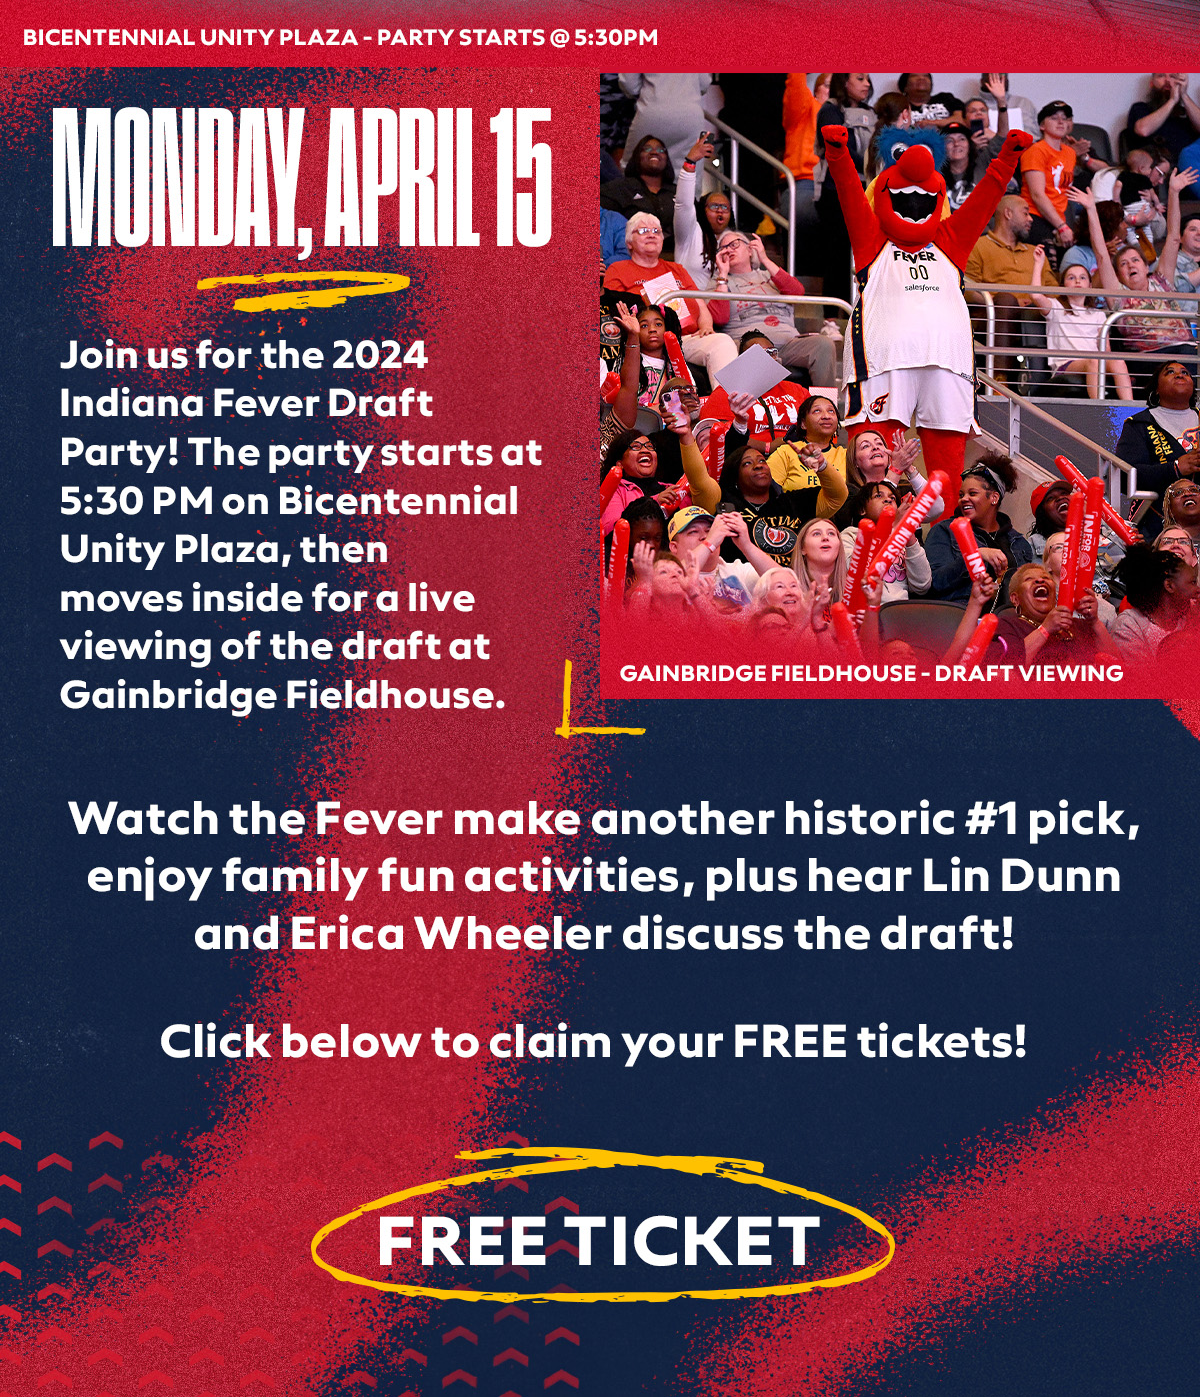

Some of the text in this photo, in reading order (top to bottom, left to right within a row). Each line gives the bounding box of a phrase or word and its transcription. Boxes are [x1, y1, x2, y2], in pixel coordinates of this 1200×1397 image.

[52, 106, 552, 261] MONDAY, APRIL 15
[893, 250, 937, 264] FEVER
[909, 265, 929, 280] 00
[904, 284, 940, 292] salesforce
[60, 338, 429, 369] Join us for the 2024
[61, 386, 433, 417] Indiana Fever Draft
[61, 436, 542, 474] Party! The party starts at
[1146, 424, 1168, 465] INDIANA
[60, 484, 518, 515] 5:30 PM on Bicentennial
[883, 493, 935, 563] MAKE NOISE
[1083, 514, 1095, 552] INFOR
[61, 532, 388, 571] Unity Plaza, then
[61, 581, 475, 612] moves inside for a live
[59, 629, 490, 668] viewing of the draft at
[60, 678, 505, 717] Gainbridge Fieldhouse.
[67, 799, 1139, 844] Watch the Fever make another historic #1 pick,
[87, 856, 1120, 901] enjoy family fun activities, plus hear Lin Dunn
[194, 914, 1013, 950] and Erica Wheeler discuss the draft!
[160, 1022, 1026, 1067] Click below to claim your FREE tickets!
[379, 1215, 820, 1267] FREE TICKET
